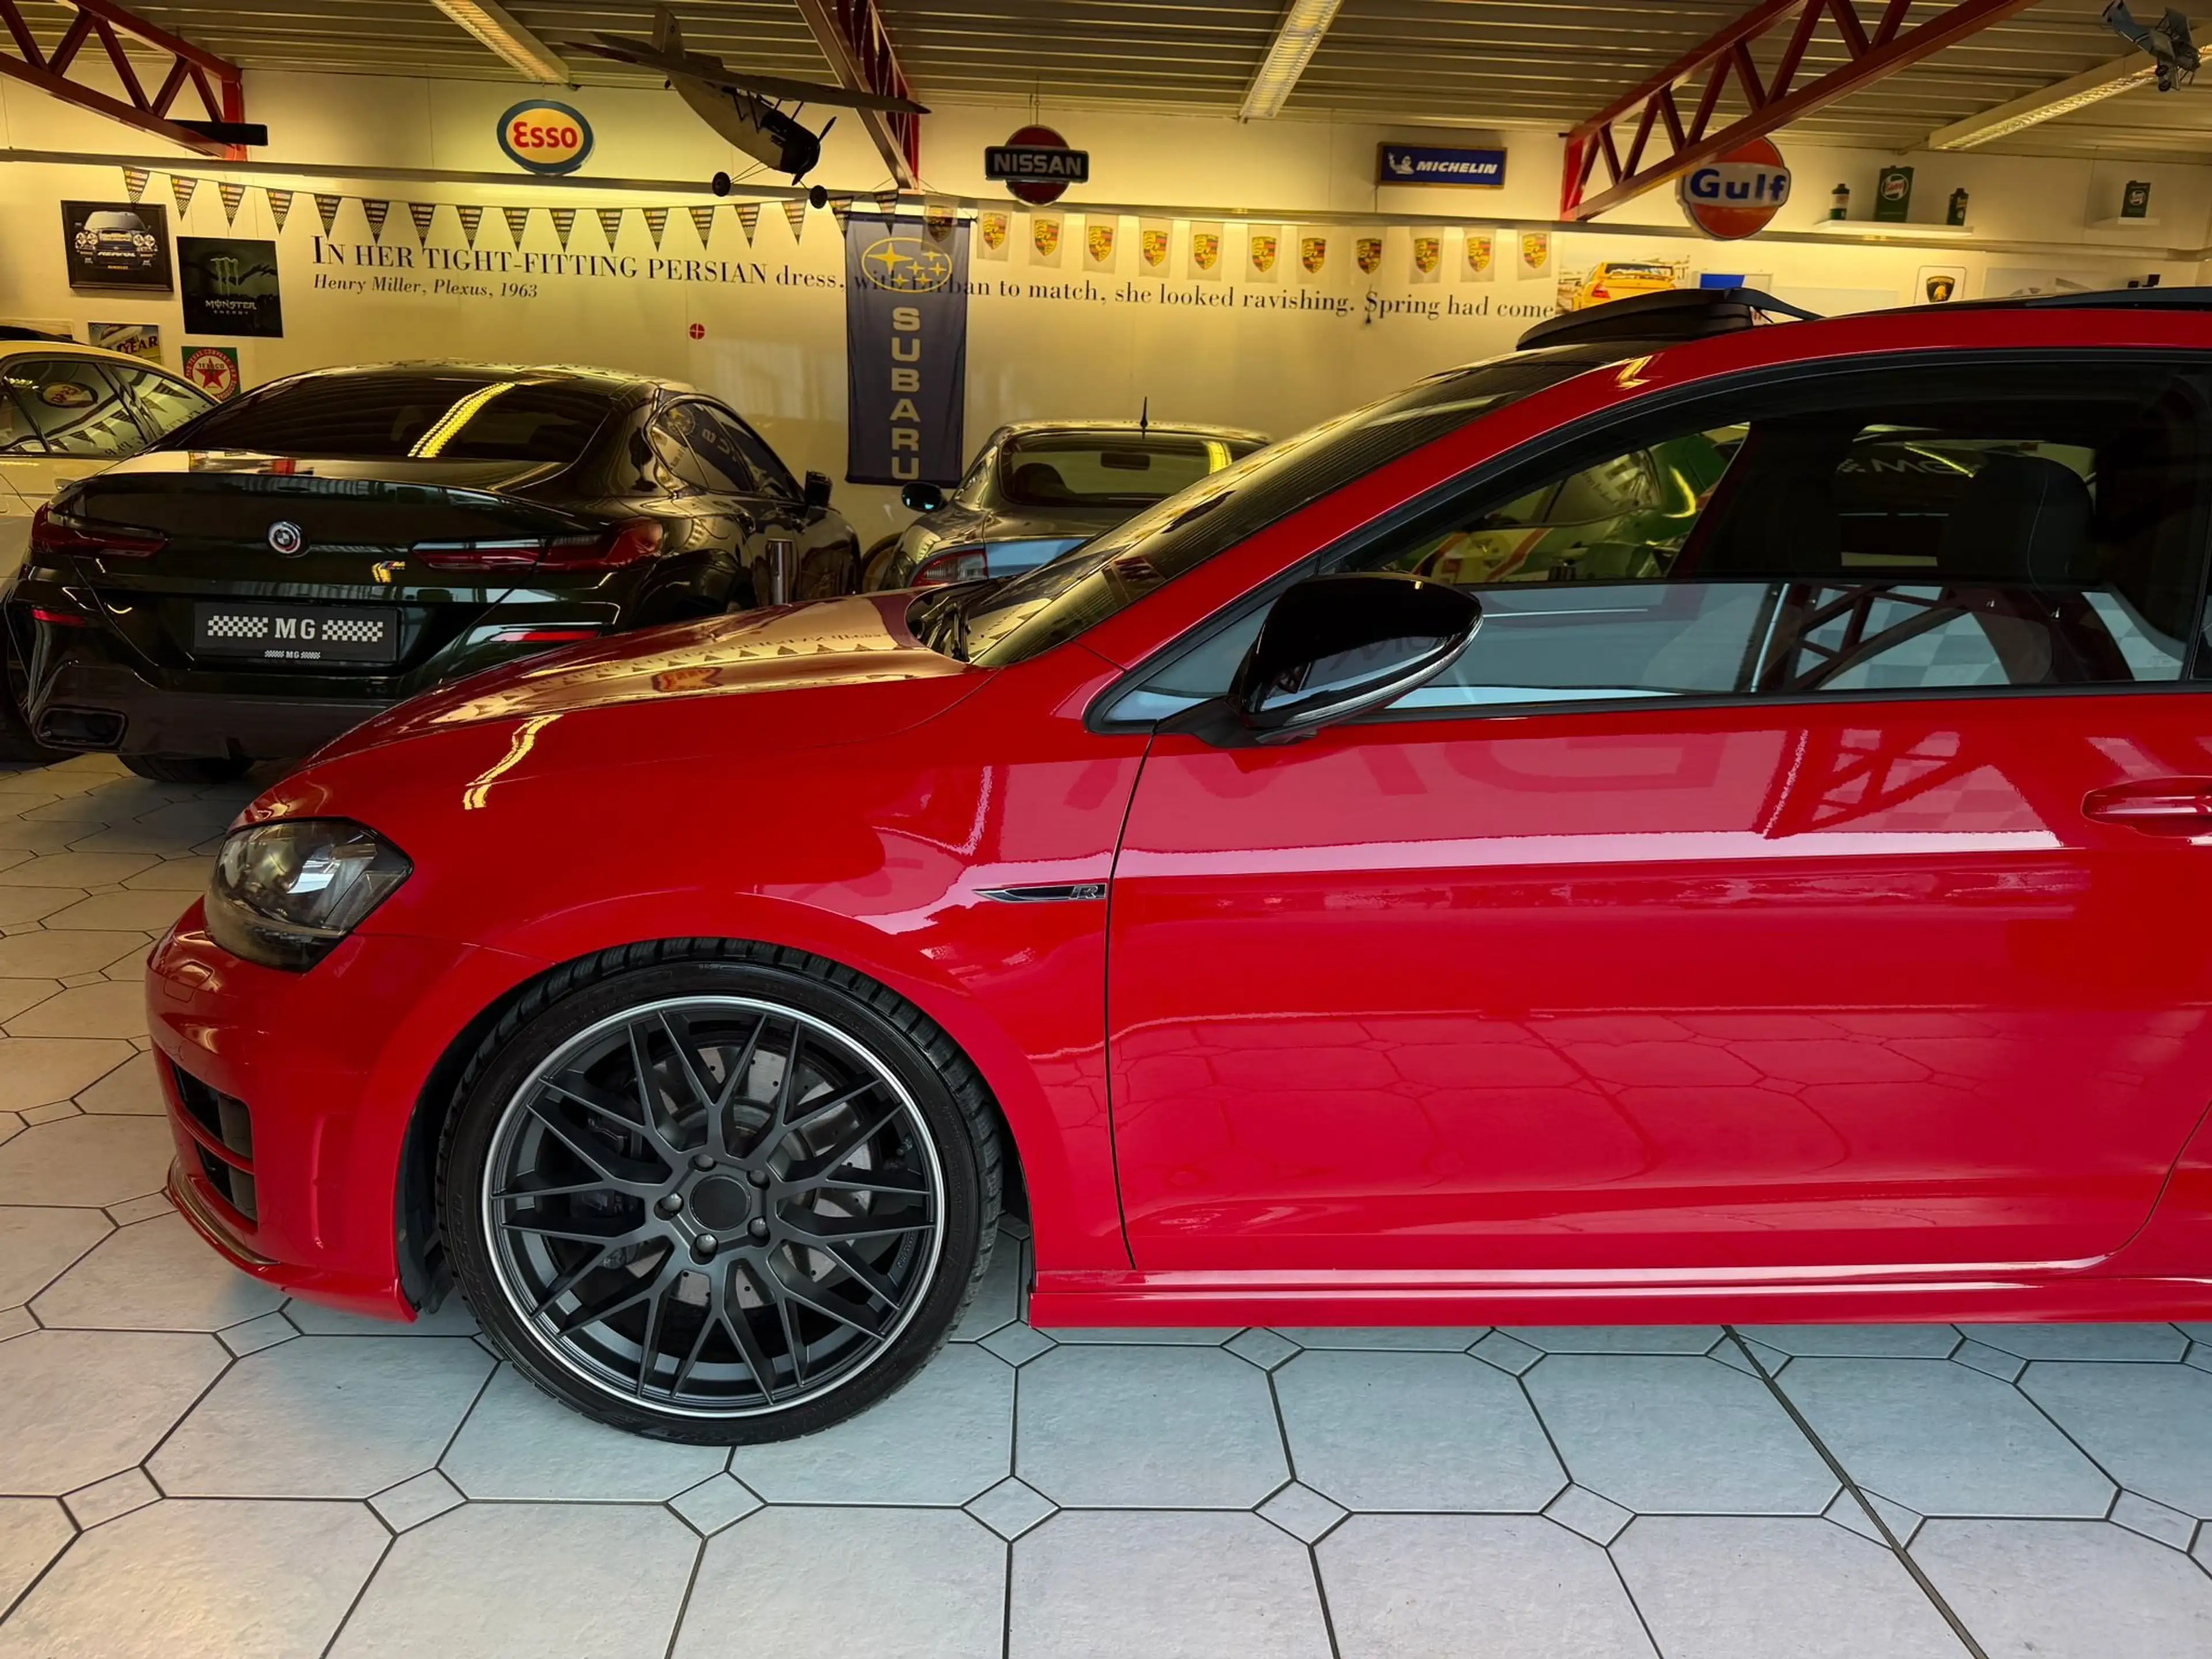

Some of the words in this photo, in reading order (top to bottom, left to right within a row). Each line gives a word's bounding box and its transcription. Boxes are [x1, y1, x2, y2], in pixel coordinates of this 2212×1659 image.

[513, 121, 578, 148] Esso
[994, 153, 1081, 175] NISSAN
[1416, 161, 1498, 174] MICHELIN
[1690, 168, 1786, 200] Gulf
[314, 274, 366, 294] Henry
[372, 276, 427, 295] Miller,
[434, 279, 494, 298] Plexus,
[501, 282, 537, 298] 1963
[354, 244, 414, 268] HER
[422, 248, 638, 278] TIGHT-FITTING
[647, 258, 767, 284] PERSIAN
[1000, 280, 1020, 297] to
[1028, 280, 1107, 305] match,
[1114, 282, 1152, 303] she
[1159, 283, 1233, 306] looked
[1243, 289, 1355, 317] ravishing.
[1364, 290, 1441, 320] Spring
[1447, 294, 1489, 316] had
[1497, 303, 1555, 317] come
[205, 300, 257, 310] MONSTER
[889, 306, 921, 480] SUBARU
[274, 618, 316, 640] MG
[286, 651, 300, 659] MG
